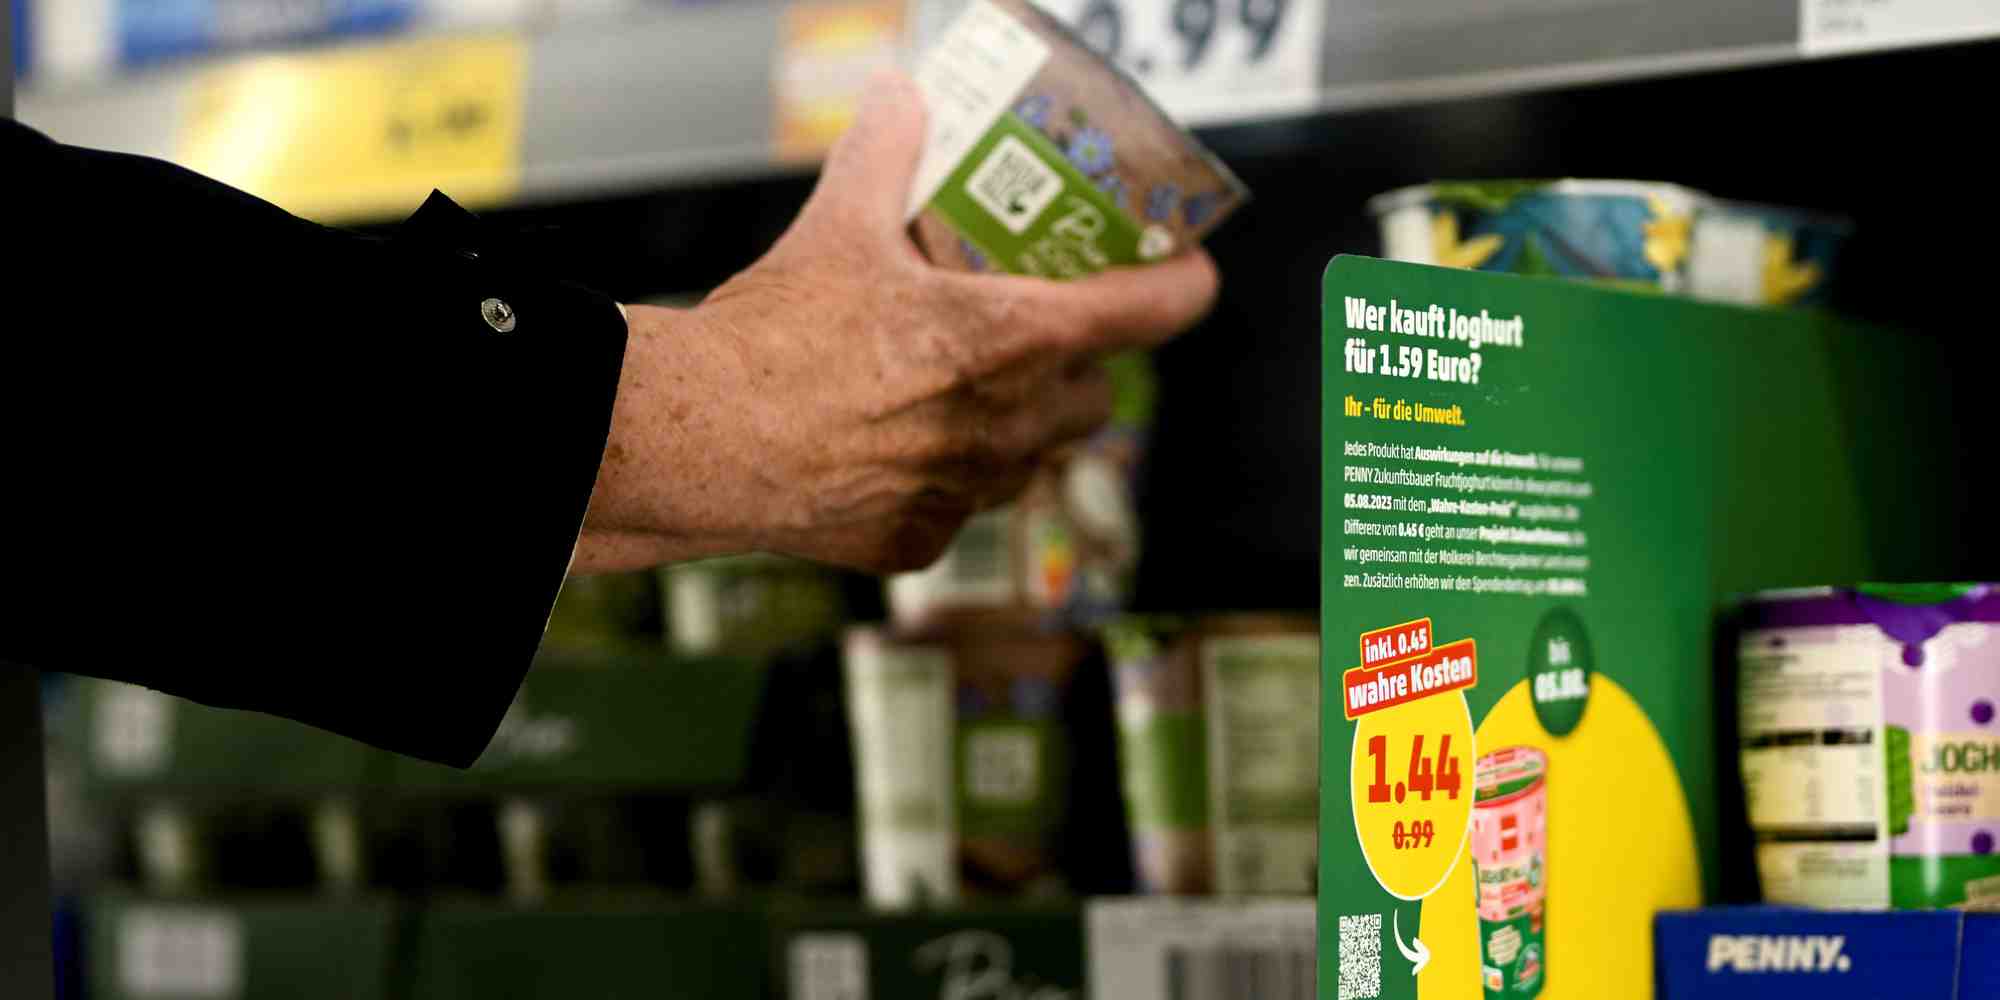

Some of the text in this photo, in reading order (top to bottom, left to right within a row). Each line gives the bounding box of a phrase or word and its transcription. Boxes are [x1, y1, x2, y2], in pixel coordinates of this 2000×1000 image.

[1344, 296, 1523, 349] Wer kauft Joghurt
[1344, 337, 1483, 385] für 1.59 Euro?
[1344, 395, 1363, 417] Ihr
[1373, 396, 1392, 420] für
[1393, 398, 1413, 421] die
[1414, 402, 1466, 427] Umwelt.
[1343, 440, 1367, 456] Jedes
[1368, 442, 1400, 460] Produkt
[1400, 443, 1414, 460] hat
[1344, 465, 1373, 483] PENNY
[1374, 467, 1435, 488] Zukunftsbauer
[1344, 492, 1392, 510] 05.08.2023
[1393, 495, 1407, 511] mit
[1408, 496, 1427, 513] dem
[1344, 519, 1381, 536] Differenz
[1382, 524, 1398, 537] von
[1398, 522, 1417, 538] 0.45
[1418, 523, 1425, 538] €
[1425, 523, 1444, 541] geht
[1445, 527, 1456, 540] an
[1343, 544, 1359, 561] wir
[1359, 546, 1407, 565] gemeinsam
[1408, 547, 1423, 563] mit
[1424, 548, 1438, 565] der
[1343, 573, 1361, 588] zen.
[1362, 571, 1402, 589] Zusätzlich
[1404, 573, 1439, 590] erhöhen
[1440, 575, 1455, 591] wir
[1364, 627, 1429, 664] inkl. 0.45
[1348, 655, 1473, 709] wahre Kosten
[1367, 733, 1462, 804] 1.44
[1392, 820, 1434, 850] 0.99
[1706, 935, 1851, 974] PENNY.
